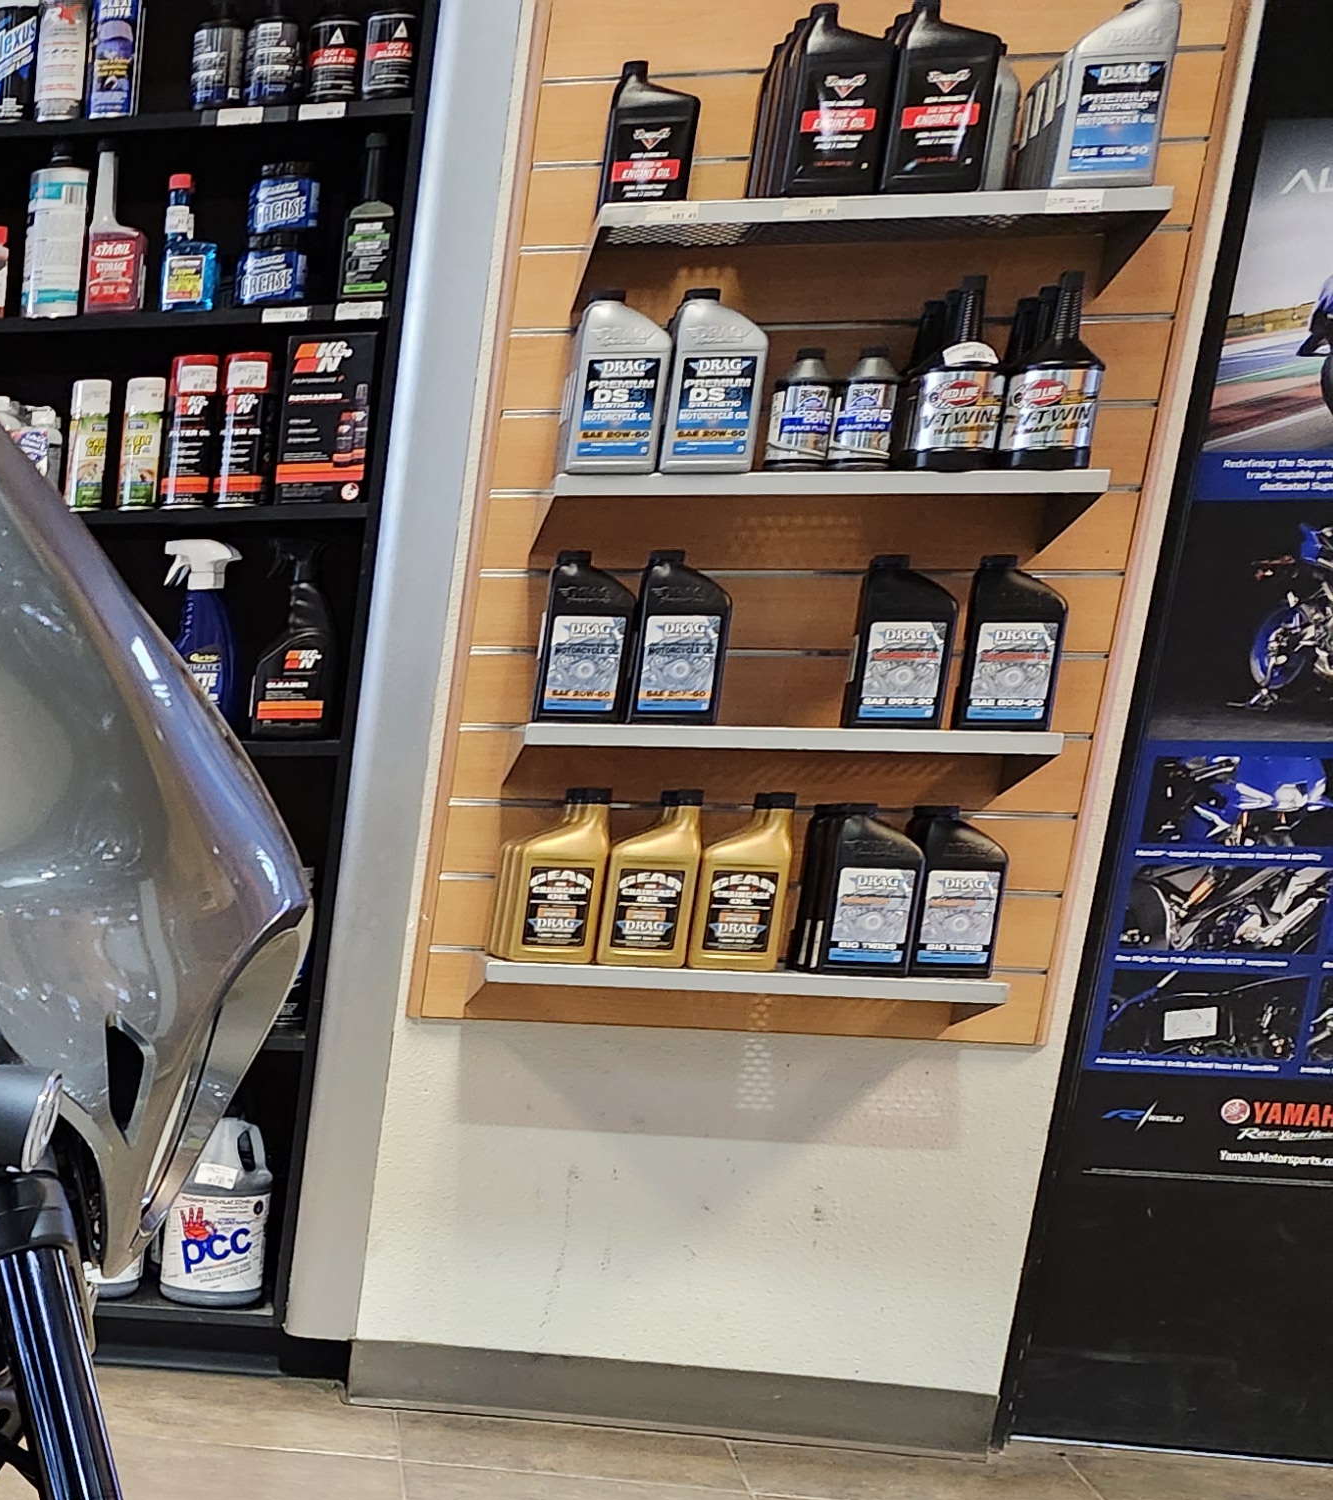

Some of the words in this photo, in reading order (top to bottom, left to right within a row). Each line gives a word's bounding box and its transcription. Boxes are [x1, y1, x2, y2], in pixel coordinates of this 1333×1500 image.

[1100, 64, 1150, 81] DRAG
[1081, 91, 1160, 105] PREMIUM
[813, 117, 851, 130] ENGINE
[852, 117, 867, 128] OIL
[914, 114, 953, 126] ENGINE
[621, 169, 655, 180] ENGINE
[656, 168, 671, 179] OIL
[255, 196, 307, 227] GREASE
[241, 268, 293, 299] GREASE
[602, 360, 647, 374] DRAG
[698, 359, 743, 373] DRAG
[588, 379, 655, 391] PREMIUM
[683, 378, 751, 390] PREMIUM
[942, 388, 961, 399] RED
[1026, 388, 1044, 399] RED
[593, 401, 645, 410] SYNTHETIC
[689, 401, 741, 410] SYNTHETIC
[582, 431, 605, 439] SAE
[677, 430, 702, 438] SAE
[1223, 459, 1276, 469] Redefining
[1278, 459, 1295, 468] the
[1246, 471, 1315, 480] track-capable
[1259, 482, 1309, 491] dedicated
[570, 622, 611, 634] DRAG
[664, 622, 706, 634] DRAG
[885, 628, 929, 640] DRAG
[995, 629, 1039, 641] DRAG
[555, 644, 606, 654] MOTORCYCLE
[608, 645, 620, 655] OIL
[648, 644, 700, 654] MOTORCYCLE
[702, 645, 715, 655] OIL
[529, 870, 592, 889] GEAR
[618, 872, 683, 892] GEAR
[711, 874, 776, 894] GEAR
[856, 875, 899, 888] DRAG
[943, 877, 985, 890] DRAG
[537, 918, 576, 930] DRAG
[624, 920, 665, 932] DRAG
[716, 923, 759, 935] DRAG
[1149, 1114, 1185, 1123] WORLD
[181, 1227, 253, 1274] pcc
